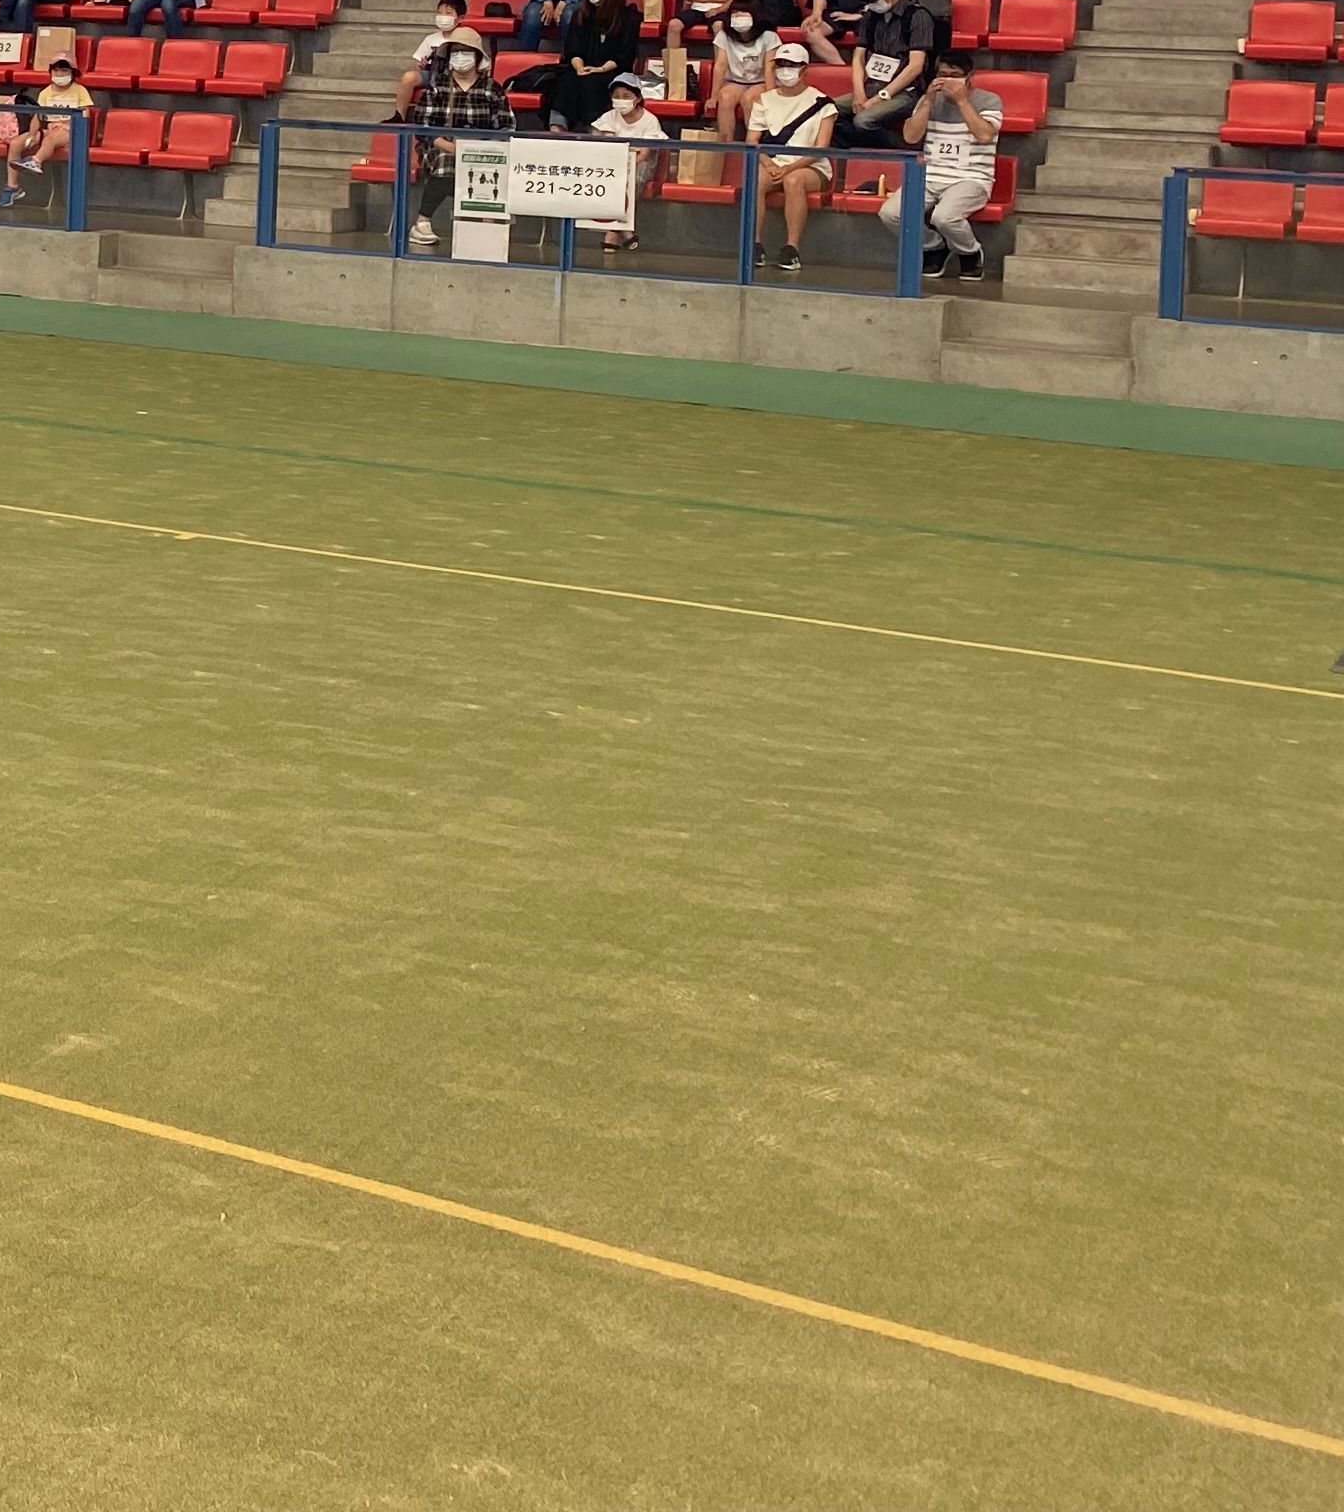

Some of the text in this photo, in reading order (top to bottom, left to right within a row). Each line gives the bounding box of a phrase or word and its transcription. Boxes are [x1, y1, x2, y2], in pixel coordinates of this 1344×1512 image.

[871, 60, 892, 75] 222
[938, 142, 961, 155] 221
[513, 163, 616, 179] 小学生低学年クラス
[524, 180, 607, 198] 221～230
